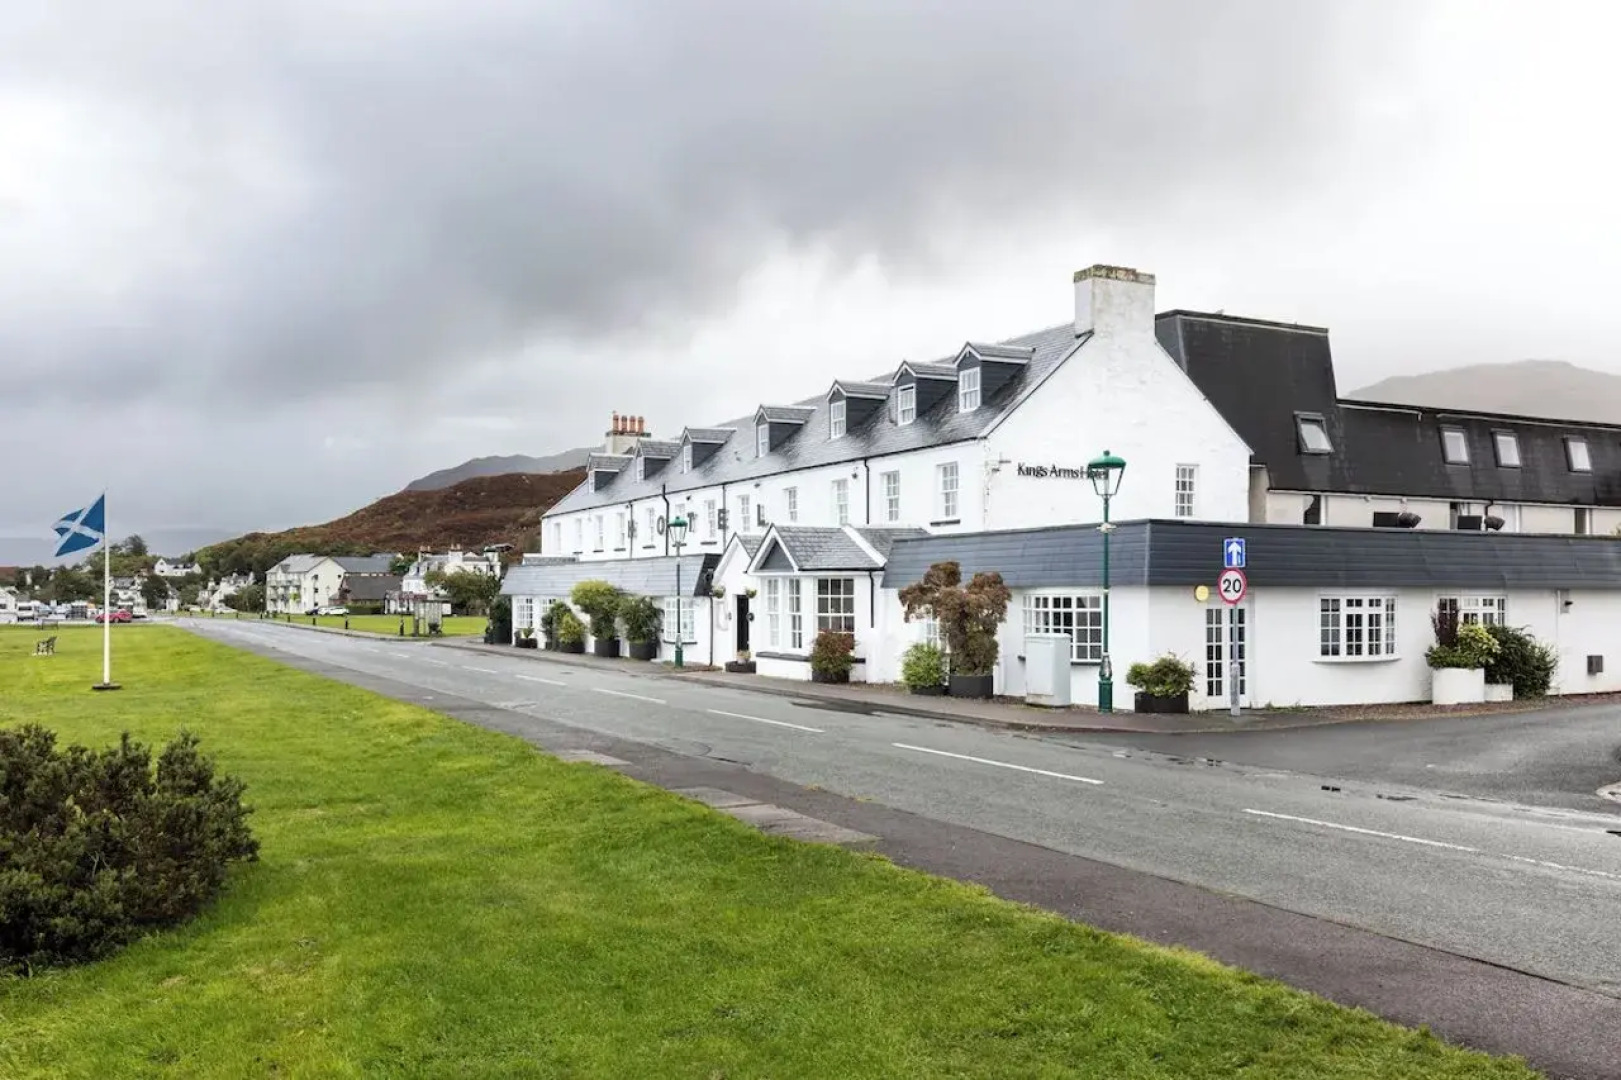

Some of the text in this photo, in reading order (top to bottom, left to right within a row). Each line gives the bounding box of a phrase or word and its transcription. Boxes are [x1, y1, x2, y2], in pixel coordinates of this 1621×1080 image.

[1017, 462, 1047, 478] Kings
[1049, 464, 1079, 479] Arms
[1222, 578, 1242, 593] 20
